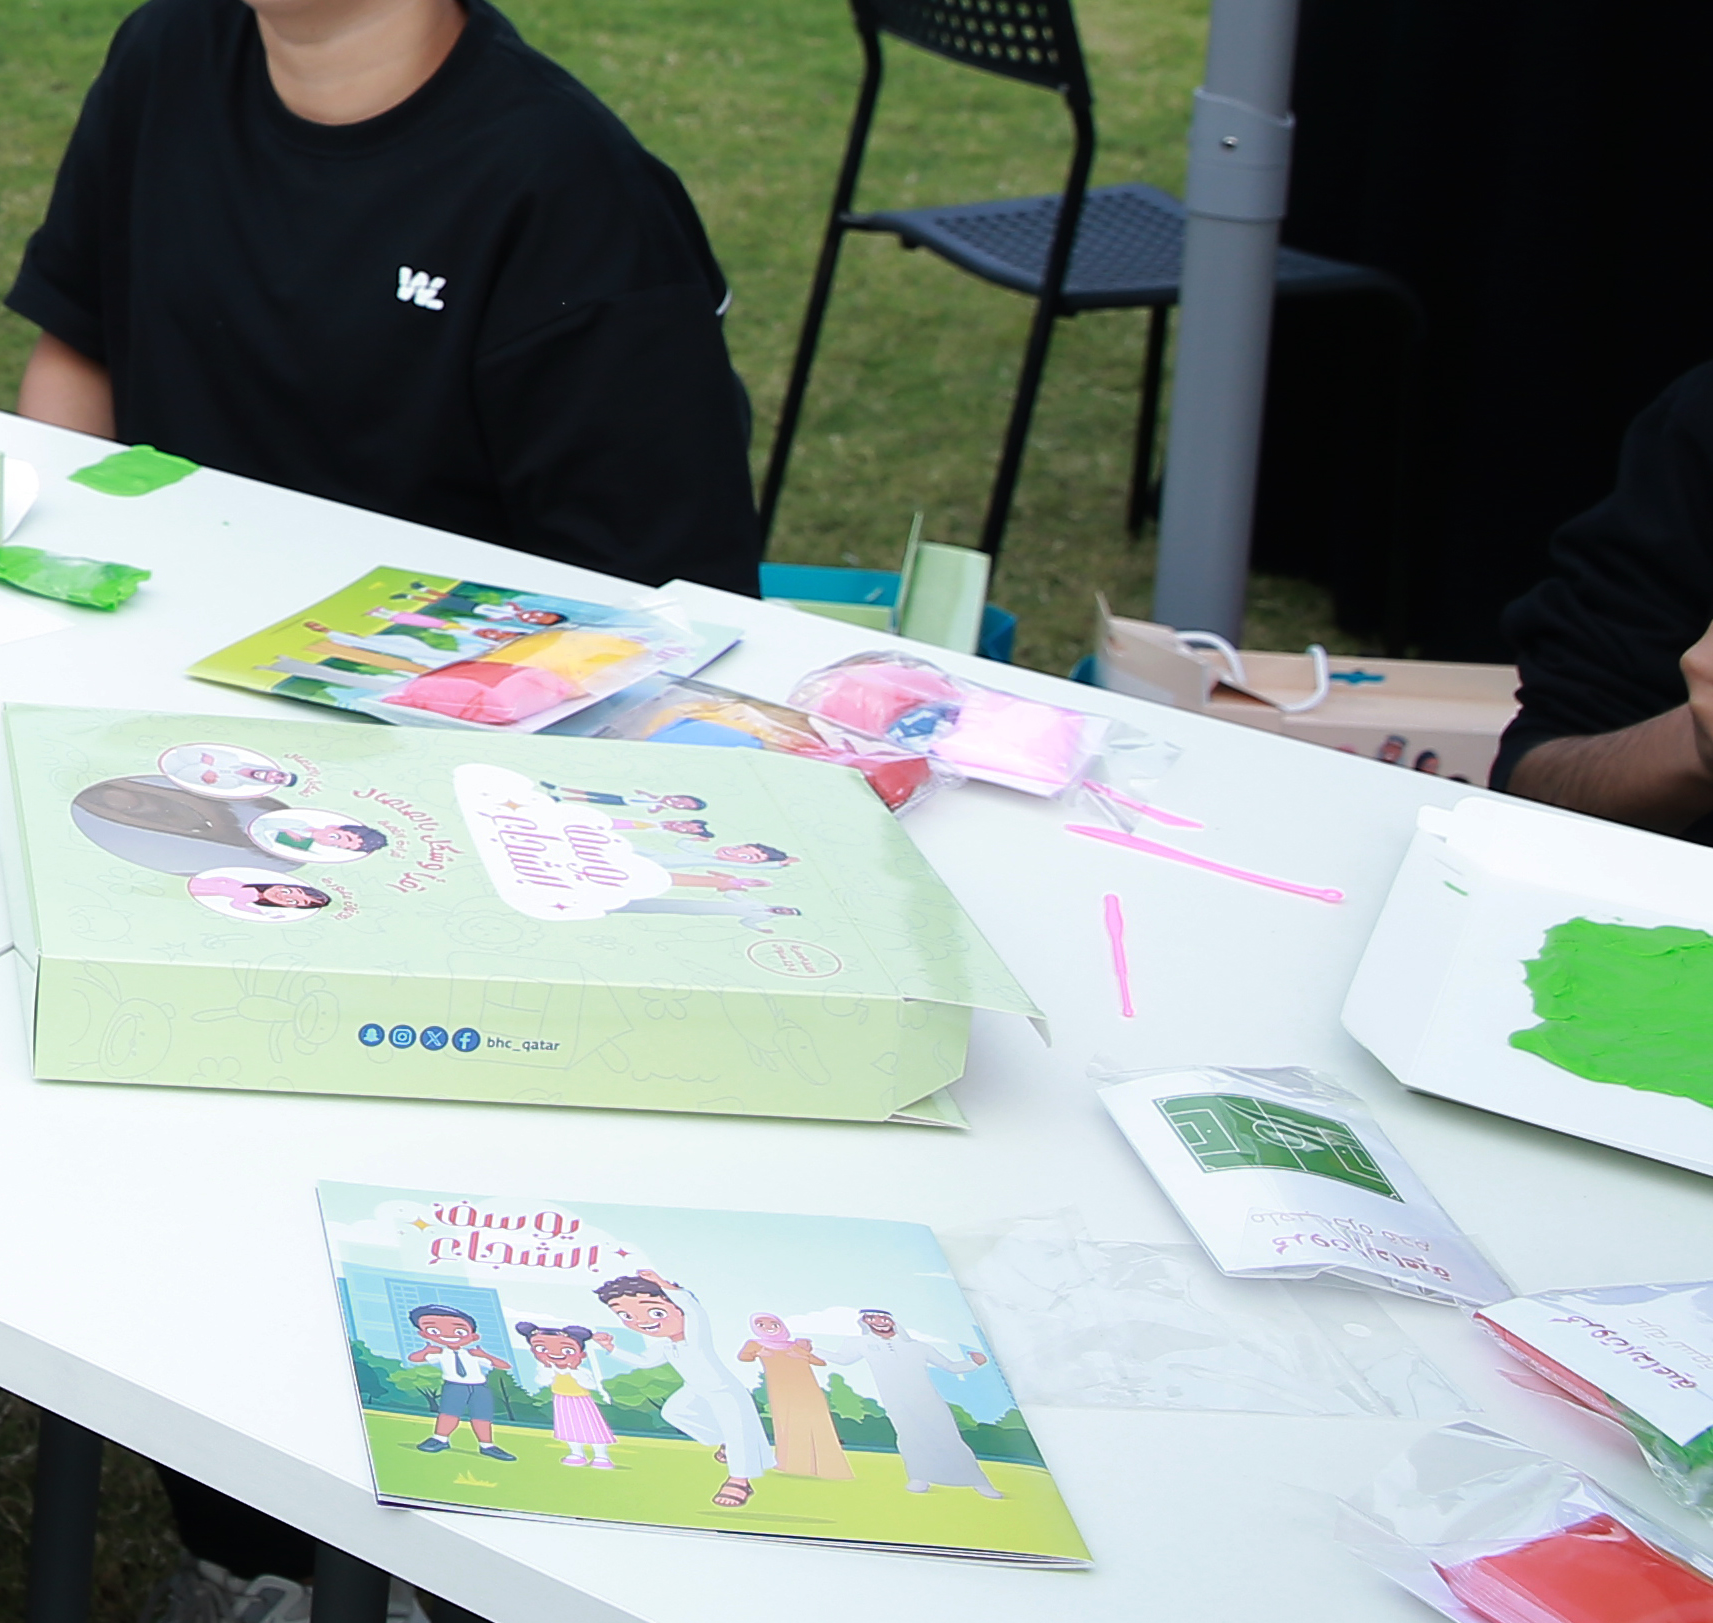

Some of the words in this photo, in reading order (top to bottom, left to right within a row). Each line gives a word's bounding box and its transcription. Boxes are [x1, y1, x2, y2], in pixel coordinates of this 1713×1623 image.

[476, 811, 574, 890] الشجاع
[563, 824, 629, 888] يوسف
[486, 1037, 560, 1053] bhc_qatar
[433, 1200, 580, 1240] يوسف
[428, 1230, 599, 1273] الشجاع
[1272, 1233, 1352, 1256] كروت
[1548, 1315, 1630, 1347] كروت
[1612, 1344, 1698, 1390] إبداعية
